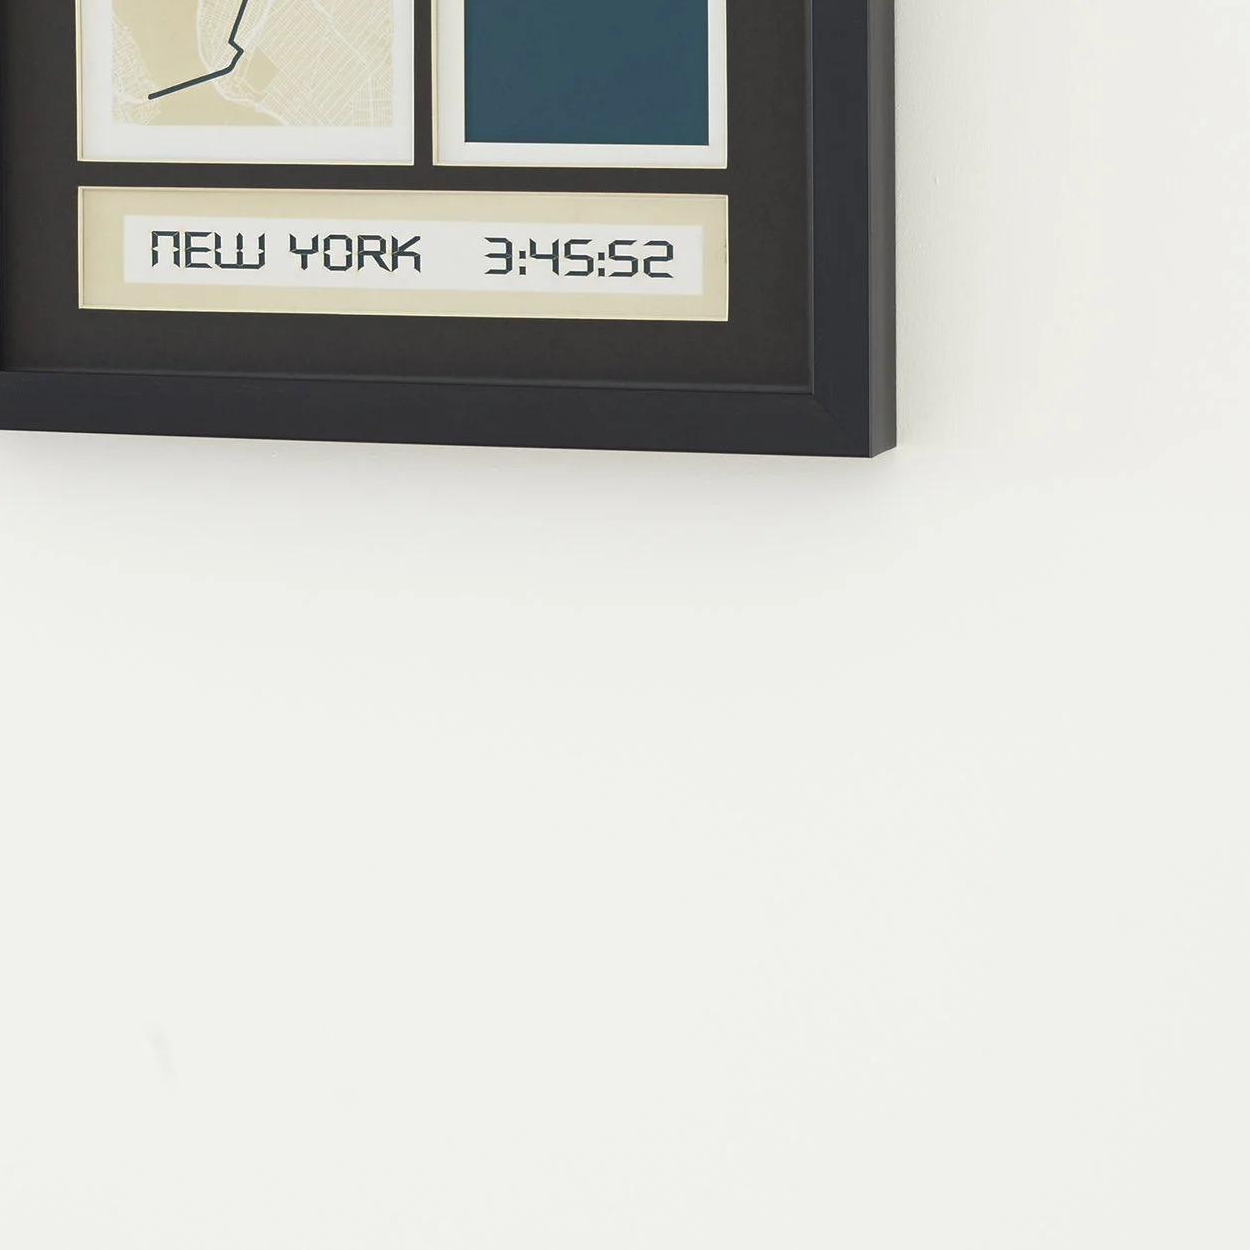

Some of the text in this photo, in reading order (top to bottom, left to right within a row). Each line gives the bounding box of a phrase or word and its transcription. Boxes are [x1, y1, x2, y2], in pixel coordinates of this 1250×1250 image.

[150, 230, 674, 279] NEW YORK 3:45:52
